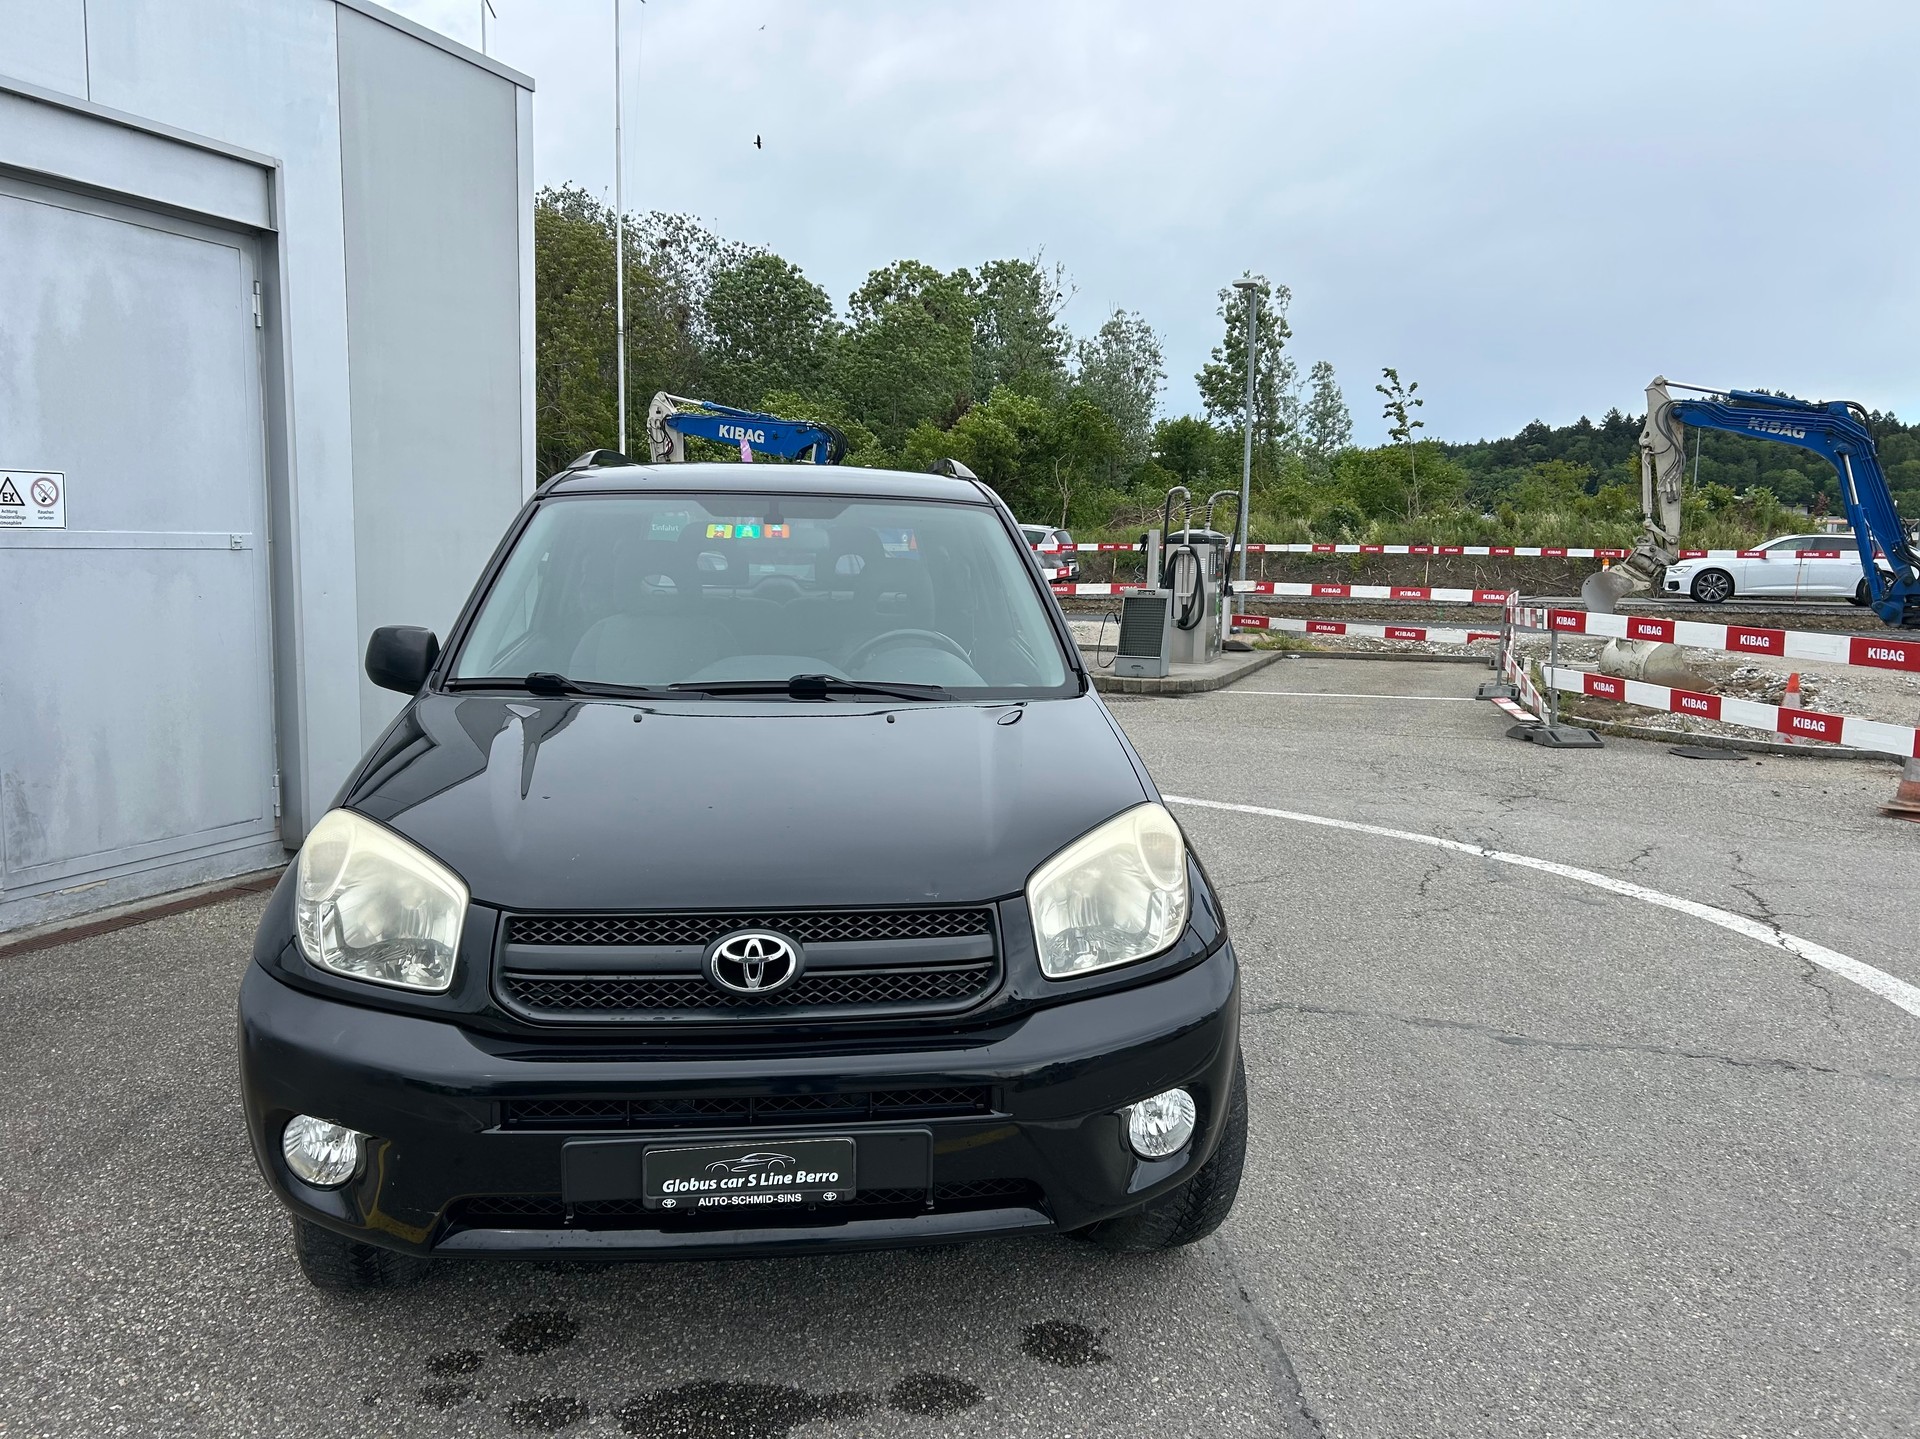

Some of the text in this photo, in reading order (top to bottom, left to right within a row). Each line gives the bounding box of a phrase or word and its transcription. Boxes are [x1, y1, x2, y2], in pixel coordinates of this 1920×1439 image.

[719, 424, 765, 444] KIBAG
[1748, 417, 1806, 439] KIBAG
[2, 492, 15, 502] EX
[1483, 593, 1505, 601] KIBAG
[1556, 616, 1576, 626] KIBAG
[1316, 624, 1336, 632] KIBAG
[1394, 630, 1416, 638] KIBAG
[1638, 624, 1662, 636] KIBAG
[1740, 634, 1770, 647] KIBAG
[1867, 647, 1905, 662] KIBAG
[1593, 681, 1615, 693] KIBAG
[1682, 697, 1707, 711] KIBAG
[1792, 716, 1826, 733] KIBAG
[662, 1170, 839, 1193] Globus car S Line Berro
[698, 1193, 802, 1207] AUTO-SCHMID-SINS
